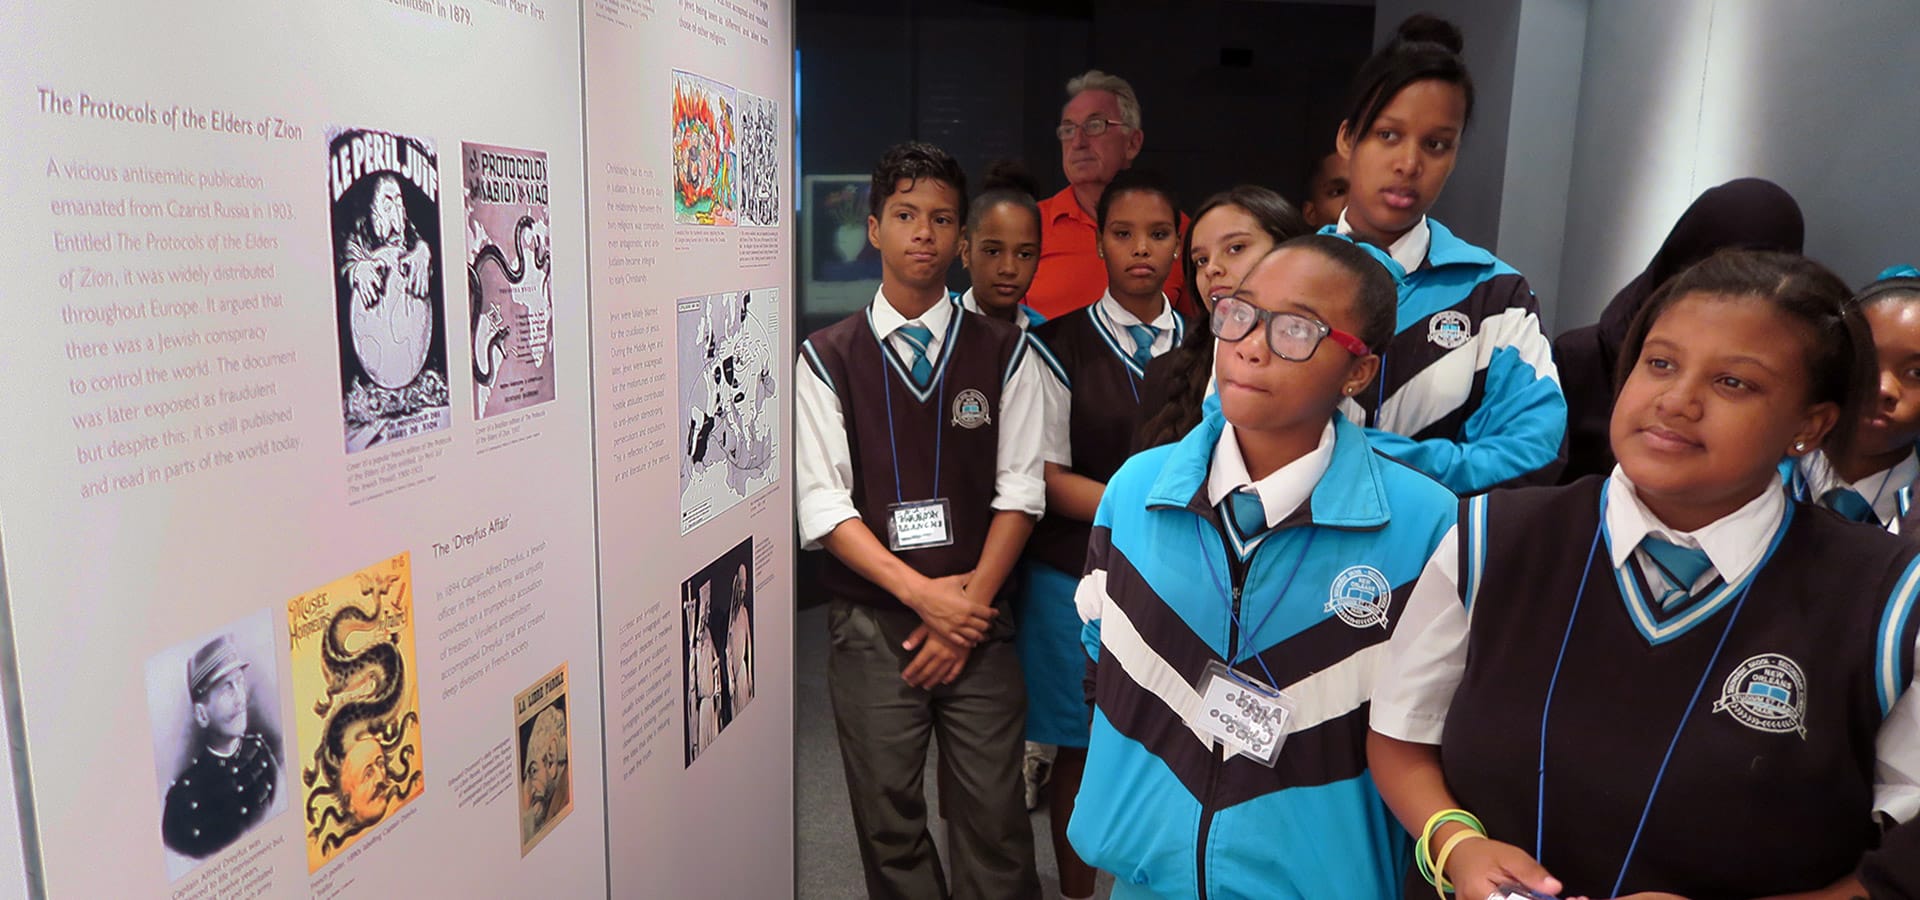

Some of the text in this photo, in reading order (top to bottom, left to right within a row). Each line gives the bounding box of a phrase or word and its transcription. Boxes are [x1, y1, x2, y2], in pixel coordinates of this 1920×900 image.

[450, 4, 472, 26] 1879.
[38, 85, 303, 140] The Protocols of the Elders of Zion
[46, 157, 264, 190] A vicious antisemitic publication
[332, 143, 352, 203] LE
[482, 152, 548, 181] PROTOCOLOS
[51, 198, 125, 218] emanated
[129, 199, 163, 218] from
[167, 200, 211, 219] Czarist
[215, 201, 250, 219] Russia
[253, 202, 263, 219] in
[54, 231, 279, 253] Entitled The Protocols of the Elders
[59, 268, 75, 290] of
[124, 267, 134, 285] it
[136, 269, 165, 284] was
[168, 264, 210, 285] widely
[213, 263, 275, 281] distributed
[62, 302, 147, 326] throughout
[219, 295, 260, 316] argued
[261, 294, 284, 310] that
[65, 325, 268, 360] there was a Jewish conspiracy
[69, 377, 87, 395] to
[90, 369, 144, 392] control
[146, 367, 168, 385] the
[217, 356, 241, 374] The
[243, 350, 298, 371] document
[72, 383, 278, 430] was later exposed as fraudulent
[77, 445, 104, 465] but
[107, 433, 159, 459] despite
[194, 425, 202, 440] it
[205, 422, 215, 438] is
[218, 417, 239, 434] still
[241, 407, 294, 433] published
[81, 476, 109, 499] and
[112, 470, 145, 493] read
[149, 466, 161, 484] in
[164, 459, 196, 483] parts
[199, 453, 214, 470] of
[214, 451, 234, 467] the
[236, 439, 270, 463] world
[432, 543, 450, 559] The
[461, 572, 485, 590] Captain
[486, 563, 502, 577] Alfred
[477, 586, 497, 604] French
[439, 618, 469, 641] convicted
[1752, 674, 1792, 690] ORLEANS
[1764, 668, 1784, 679] NEW
[518, 701, 526, 714] LA
